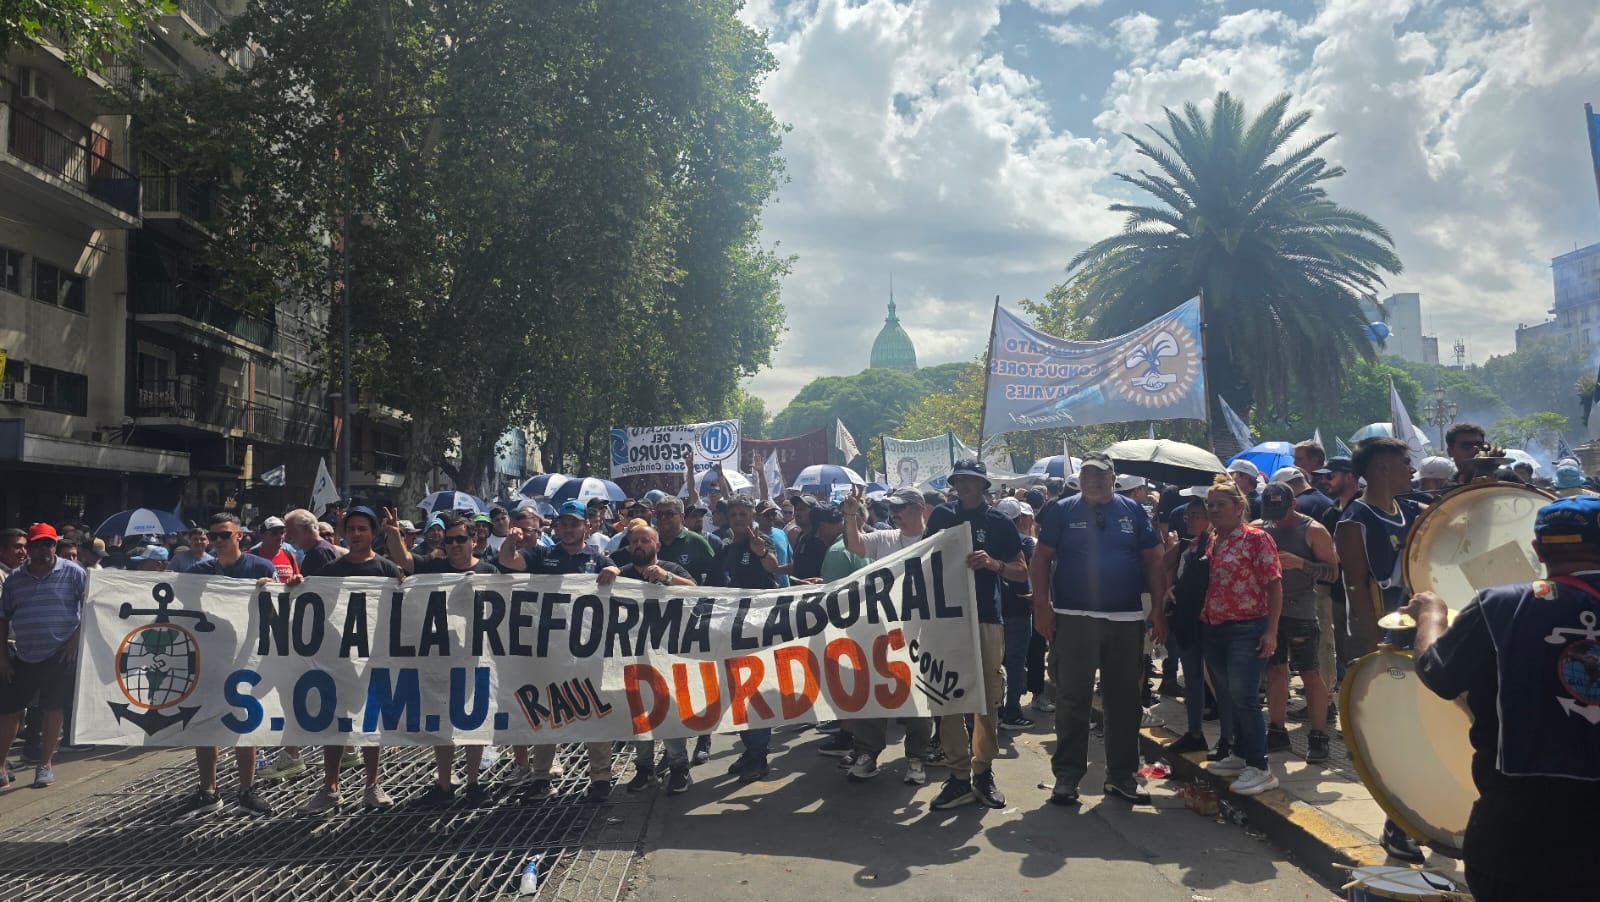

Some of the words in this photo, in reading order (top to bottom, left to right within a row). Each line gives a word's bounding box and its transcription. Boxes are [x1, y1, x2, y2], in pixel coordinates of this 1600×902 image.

[257, 591, 326, 657] NO
[338, 591, 370, 658] A
[387, 590, 451, 657] LA
[471, 590, 714, 658] REFORMA
[730, 549, 964, 651] LABORAL
[222, 666, 510, 734] S.O.M.U.
[514, 676, 613, 732] RAUL
[623, 628, 912, 735] DURDOS
[908, 642, 965, 699] COND.
